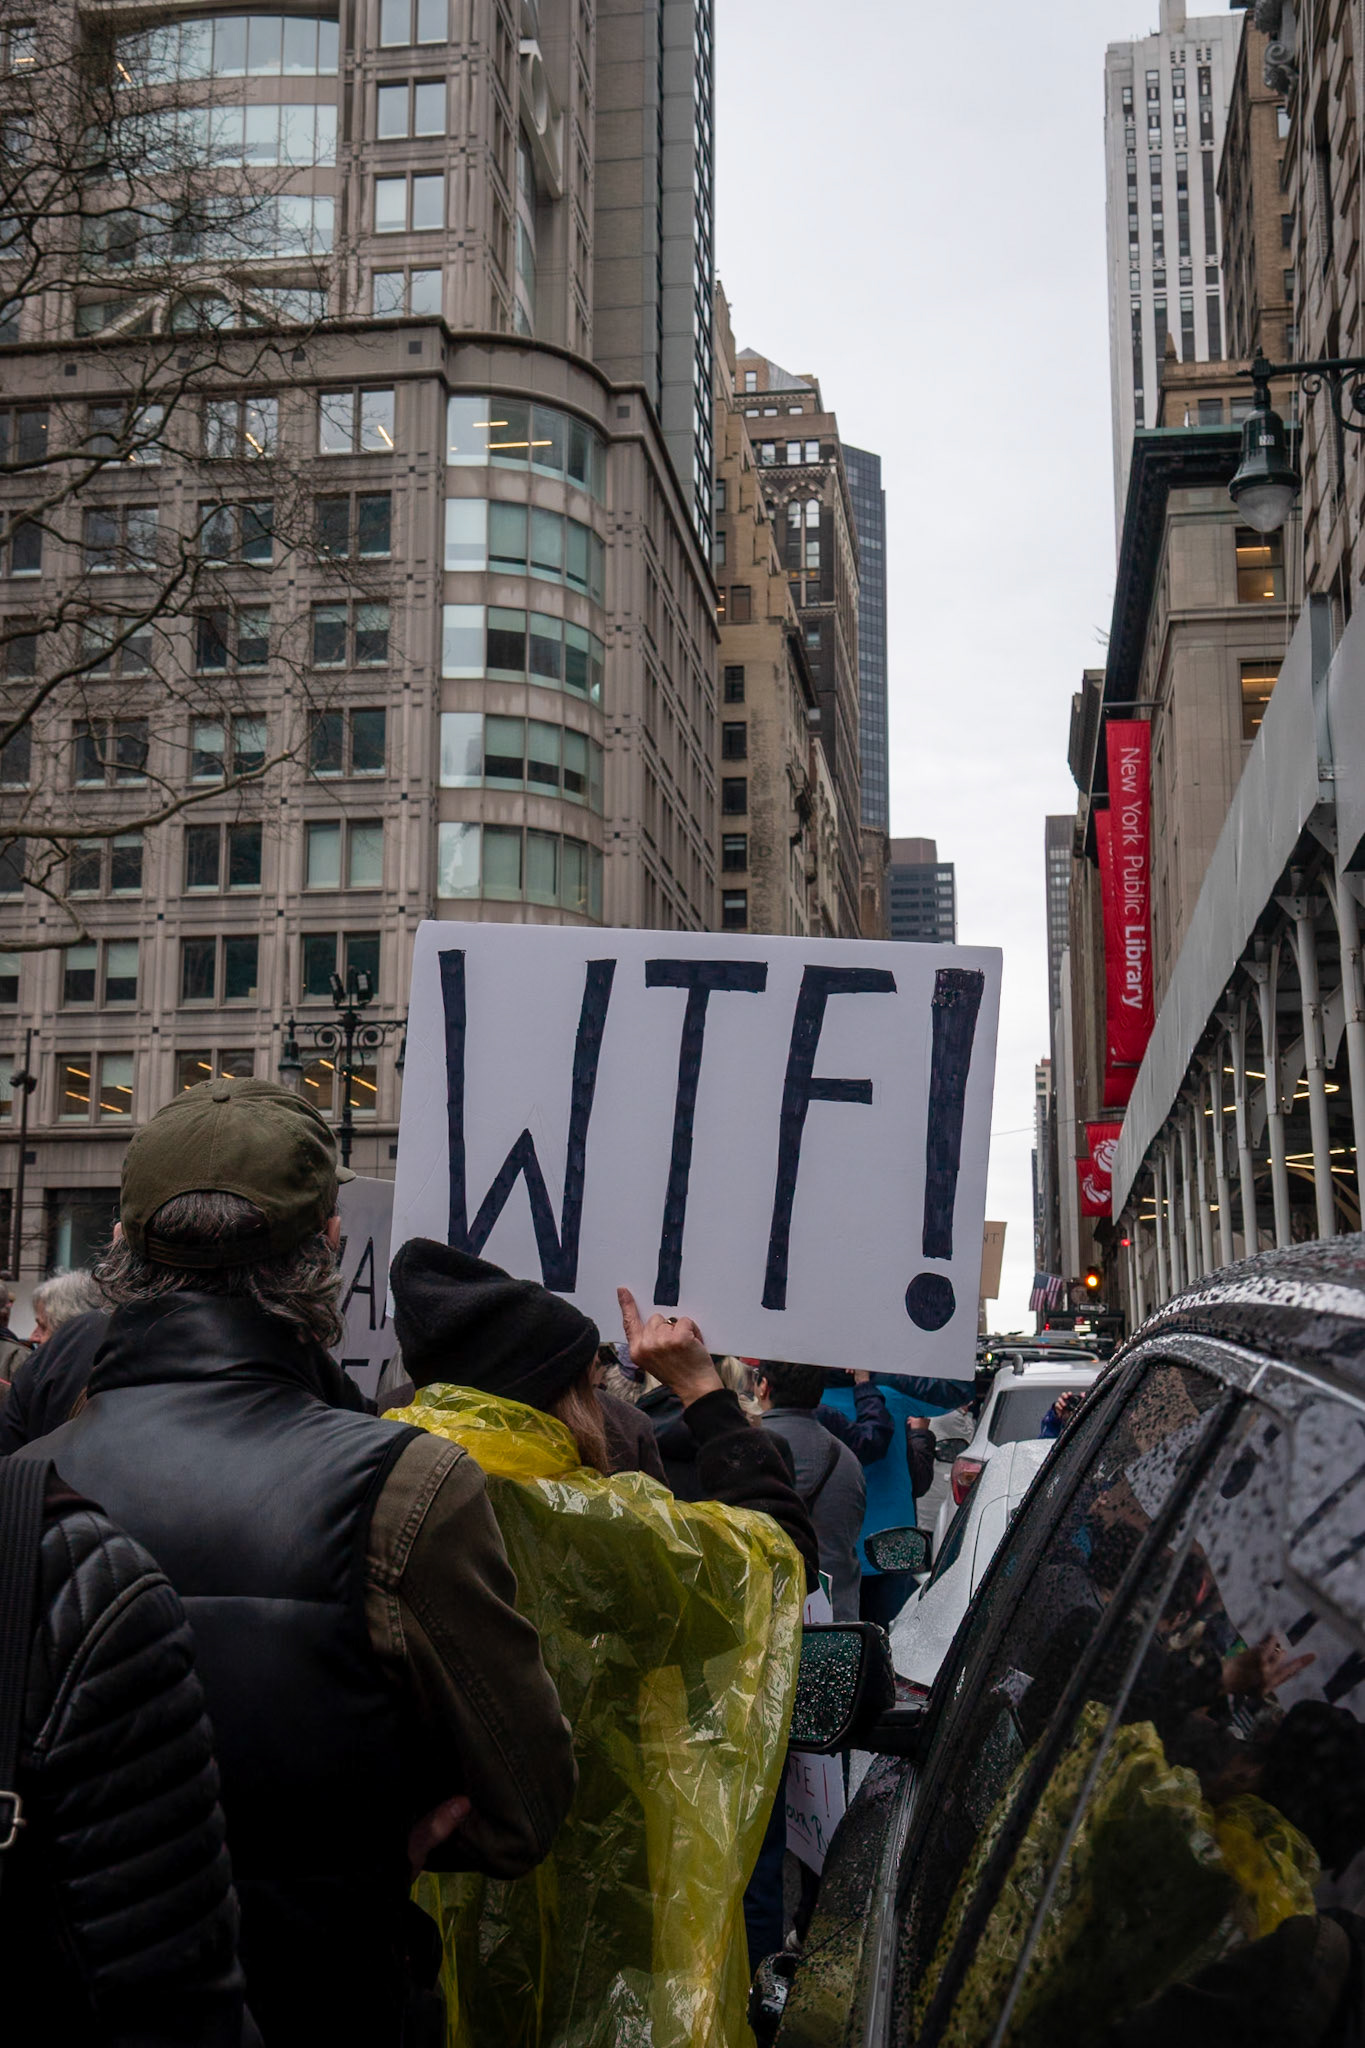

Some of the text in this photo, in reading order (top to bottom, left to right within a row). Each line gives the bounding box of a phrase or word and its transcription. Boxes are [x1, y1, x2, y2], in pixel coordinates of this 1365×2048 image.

[1120, 747, 1146, 1009] New York Public Library
[438, 949, 985, 1331] WTF!
